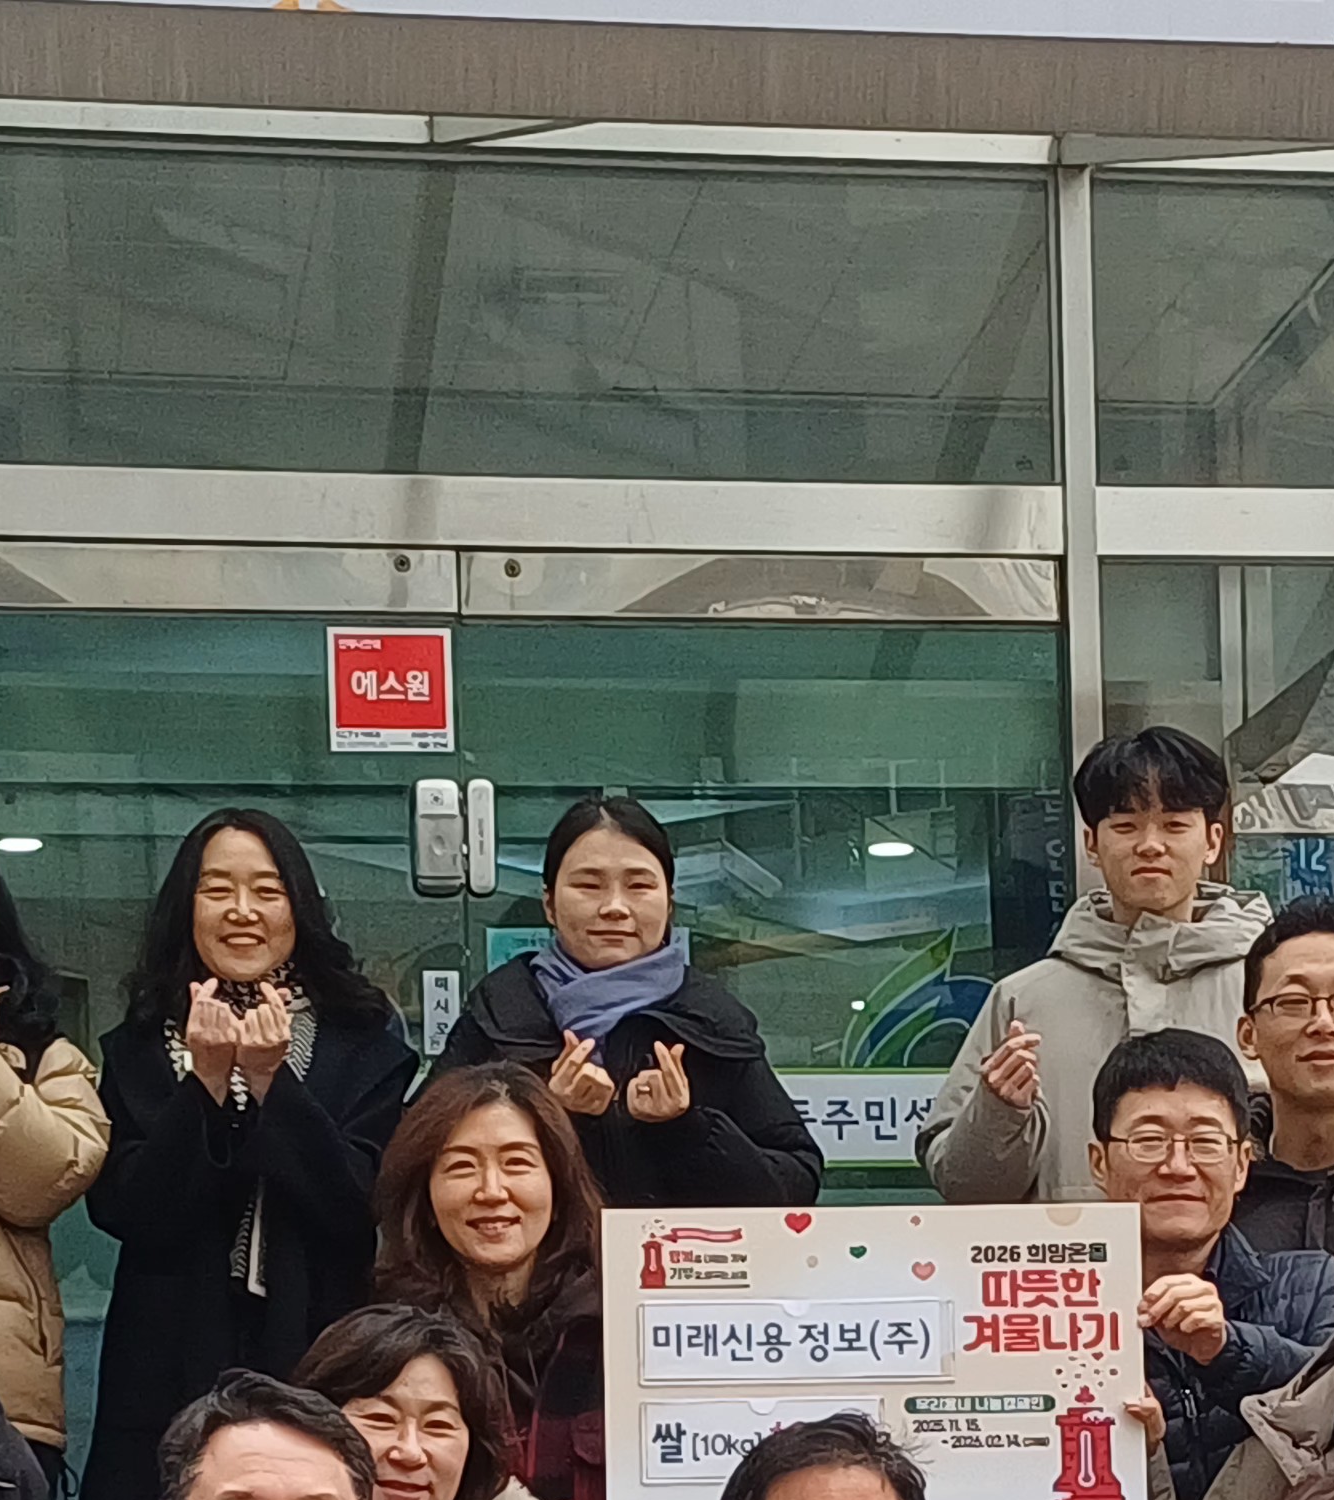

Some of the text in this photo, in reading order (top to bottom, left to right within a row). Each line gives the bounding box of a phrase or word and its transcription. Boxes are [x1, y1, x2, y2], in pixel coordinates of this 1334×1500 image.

[351, 669, 431, 701] 에스원
[970, 1245, 1021, 1264] 2026
[981, 1268, 1101, 1309] 따뜻한
[962, 1311, 1120, 1353] 겨울나기
